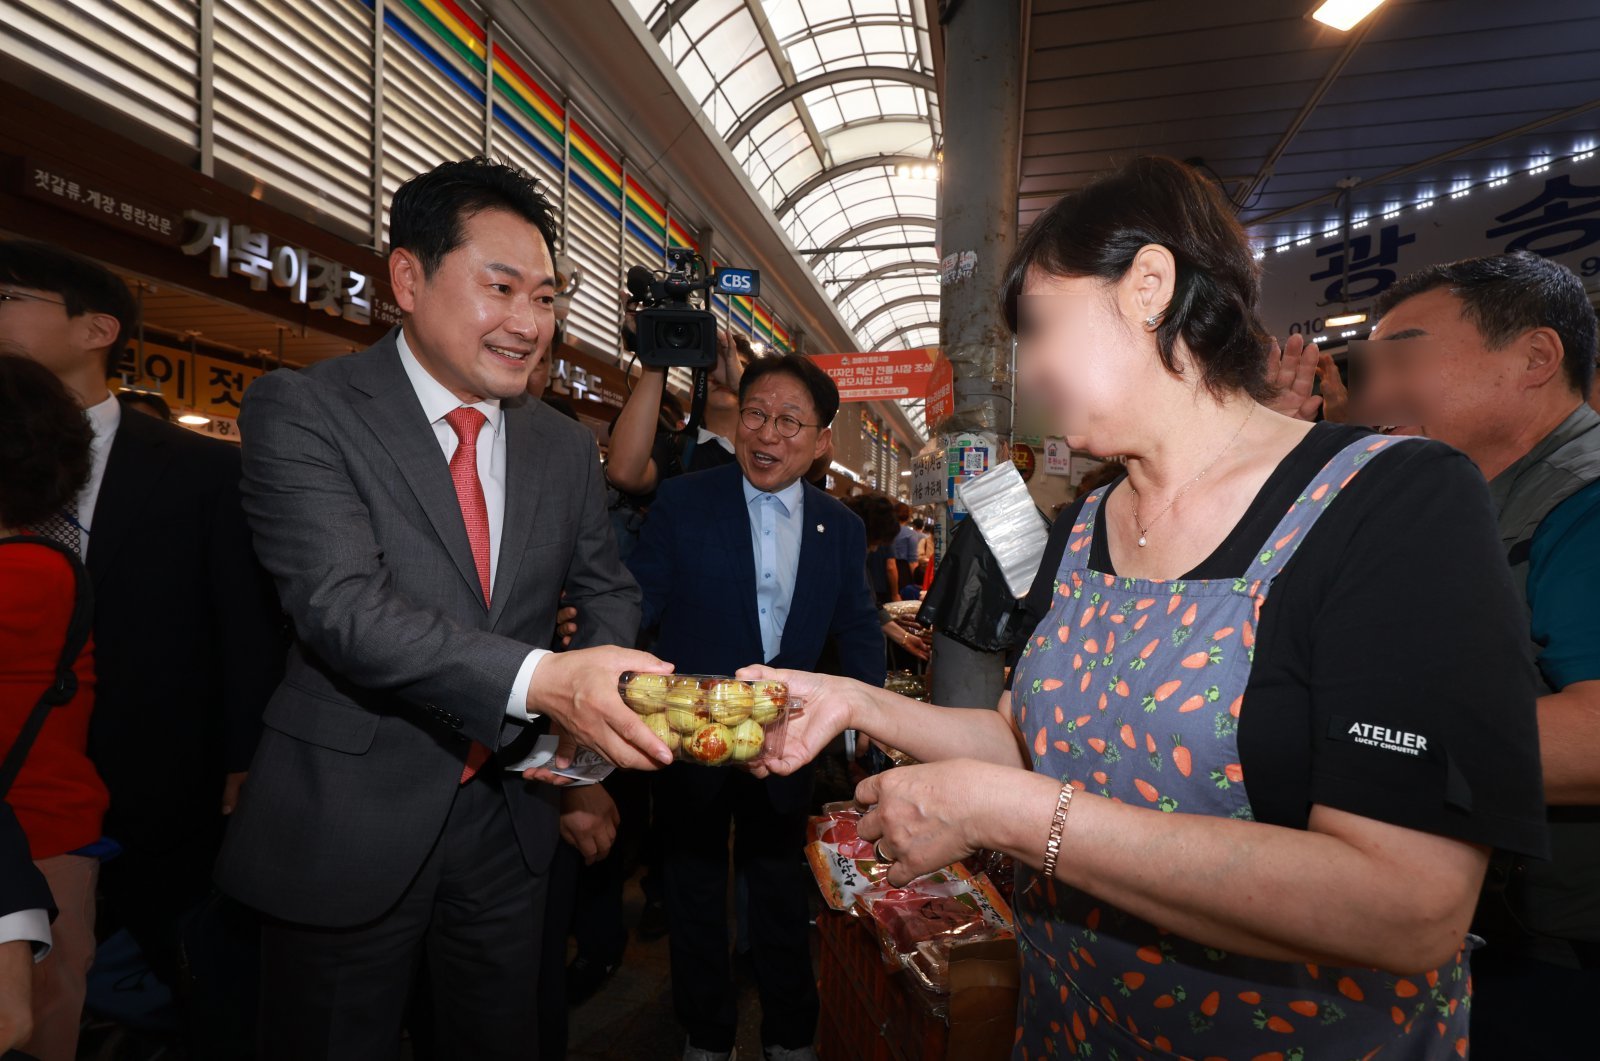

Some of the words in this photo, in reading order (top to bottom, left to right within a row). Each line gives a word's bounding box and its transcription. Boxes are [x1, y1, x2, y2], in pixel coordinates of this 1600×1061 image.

[180, 209, 376, 326] 거북이젓갈
[1310, 224, 1416, 304] 광
[721, 274, 751, 289] CBS
[1347, 721, 1427, 751] ATELIER
[1354, 736, 1380, 747] LUCKY
[1379, 742, 1419, 756] CHOUETTE
